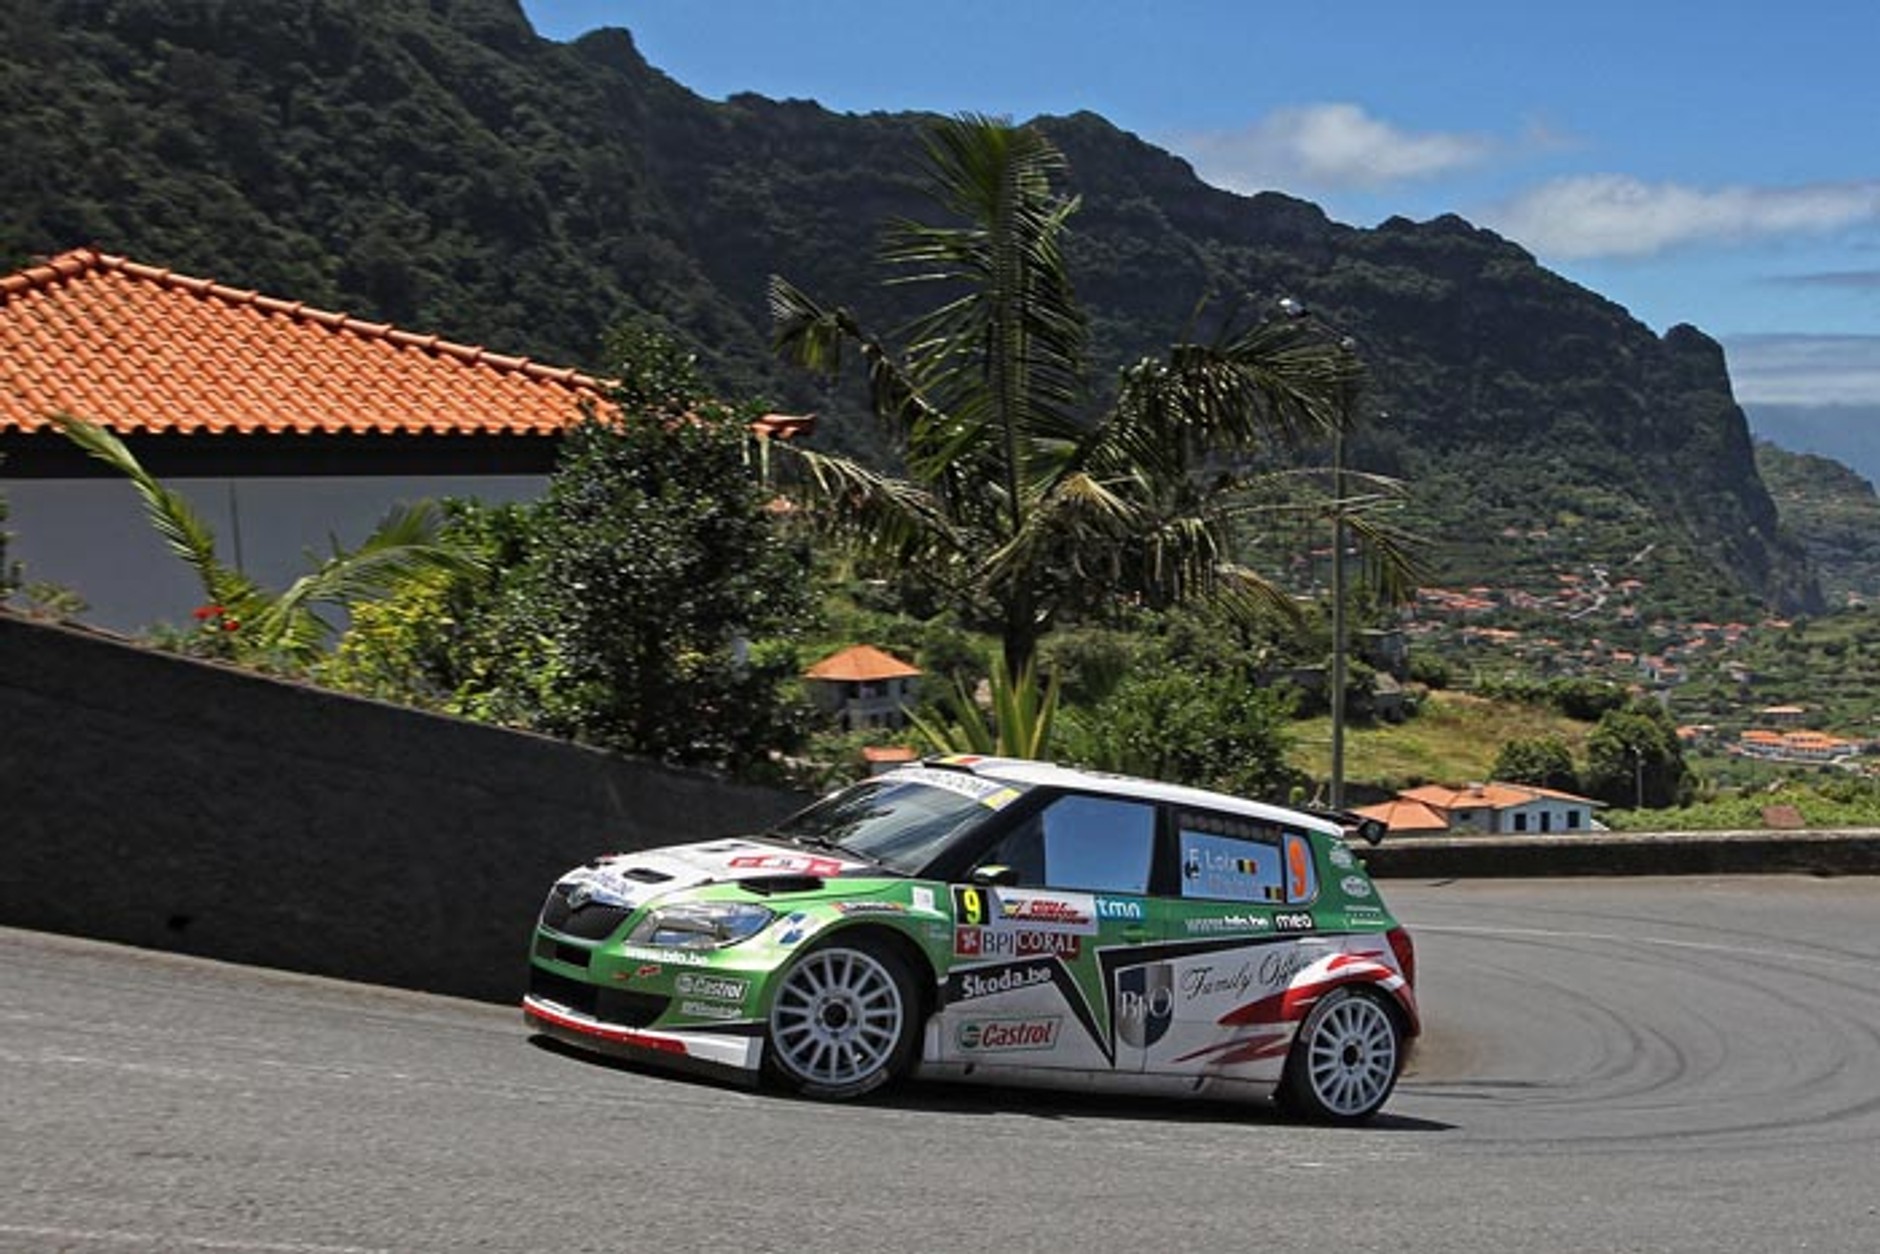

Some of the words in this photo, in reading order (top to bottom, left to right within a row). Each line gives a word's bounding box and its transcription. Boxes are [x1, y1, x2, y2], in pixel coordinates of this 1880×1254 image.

[1288, 837, 1306, 898] 9
[963, 886, 982, 925] 9
[1097, 899, 1141, 918] tmn
[1017, 930, 1078, 953] CORAL
[690, 974, 743, 998] Castrol
[961, 967, 1052, 998] Škoda.be
[1181, 964, 1252, 1000] Family
[982, 1021, 1053, 1048] Castrol
